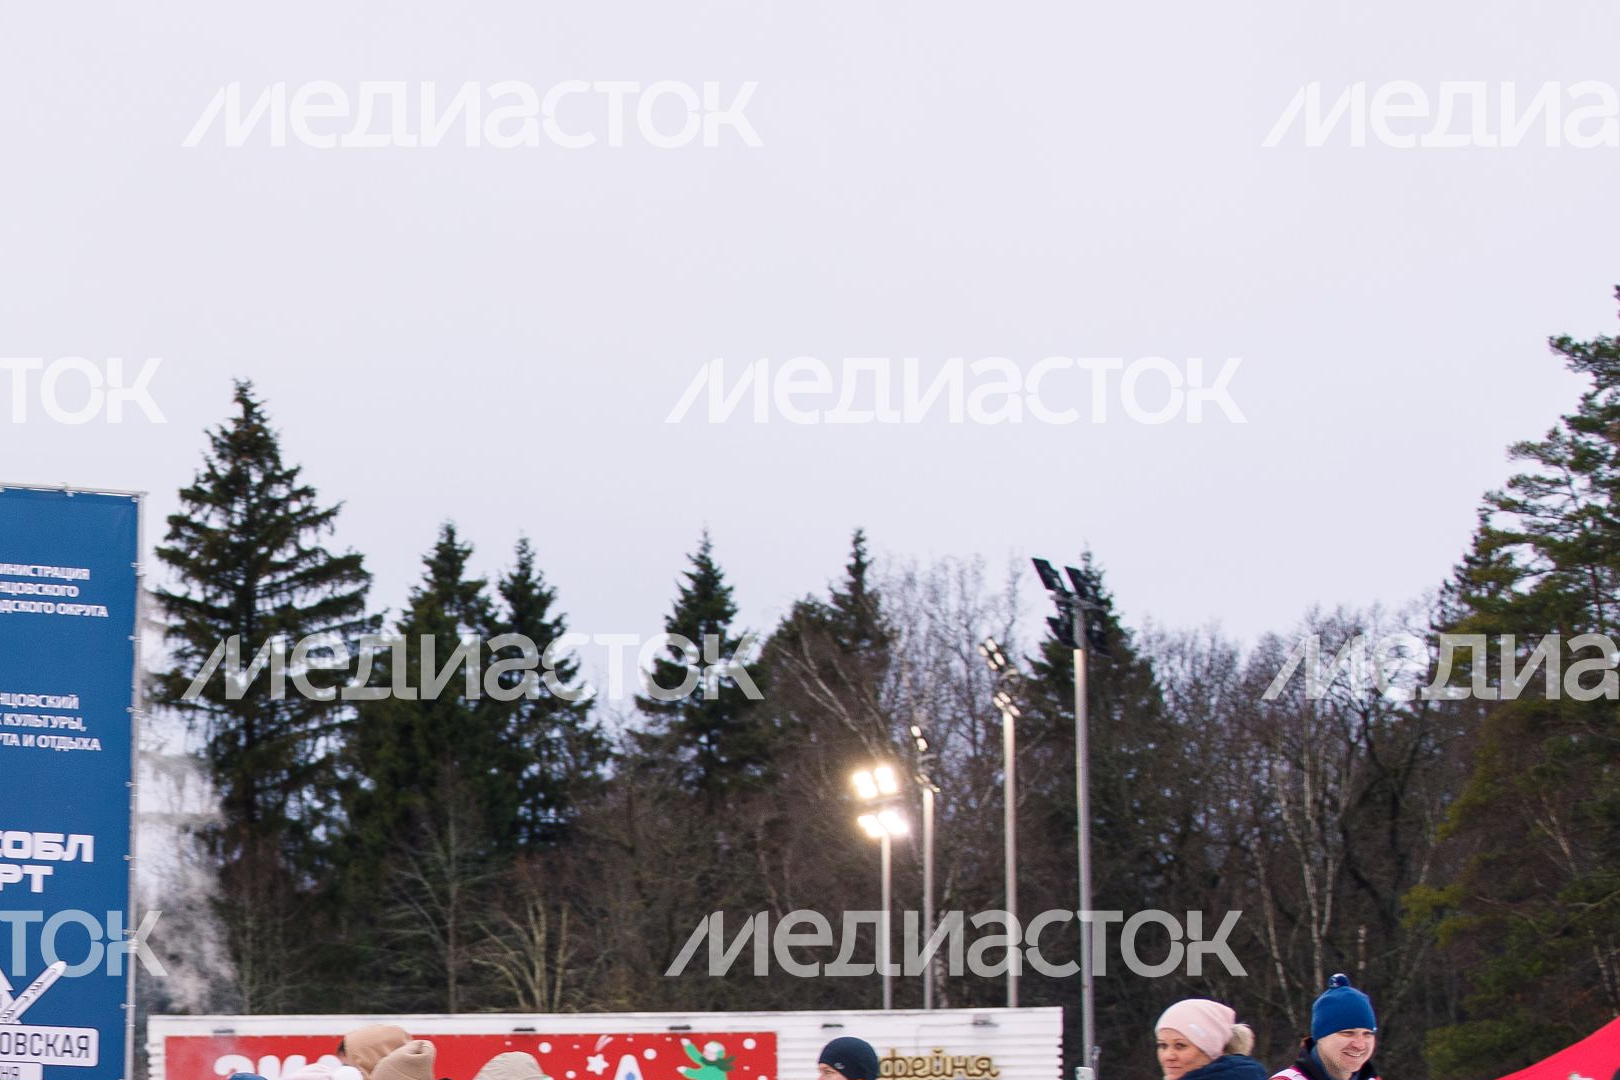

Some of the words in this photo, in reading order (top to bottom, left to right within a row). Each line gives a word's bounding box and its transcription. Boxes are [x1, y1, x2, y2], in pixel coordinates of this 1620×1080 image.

[56, 603, 109, 617] ОКРУГА
[4, 713, 87, 731] КУЛЬТУРЫ,
[22, 735, 35, 746] И
[37, 735, 102, 751] ОТДЫХА
